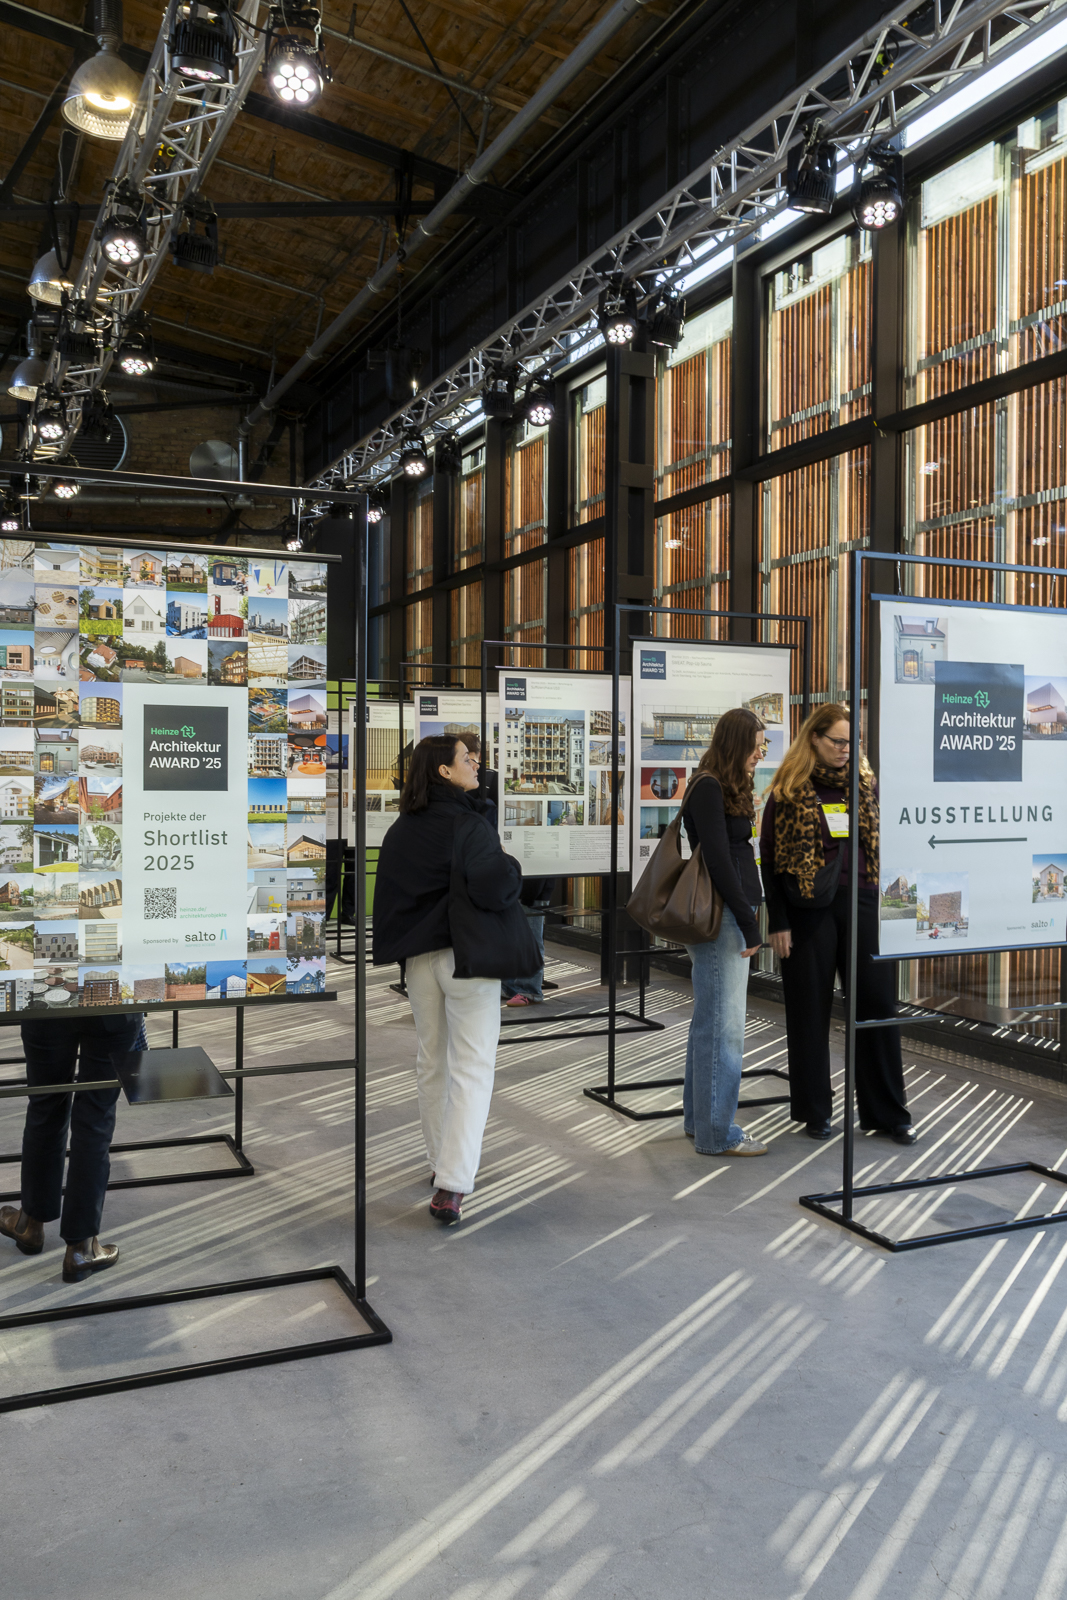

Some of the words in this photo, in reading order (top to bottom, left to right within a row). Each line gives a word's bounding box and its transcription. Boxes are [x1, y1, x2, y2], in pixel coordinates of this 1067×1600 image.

[942, 693, 973, 704] Heinze
[940, 711, 1016, 728] Architektur
[150, 727, 179, 735] Heinze
[149, 740, 221, 752] Architektur
[939, 734, 994, 750] AWARD
[996, 735, 1016, 751] '25
[149, 757, 200, 769] AWARD
[202, 757, 222, 769] '25
[143, 812, 187, 823] Projekte
[189, 812, 207, 821] der
[899, 805, 1053, 825] AUSSTELLUNG
[143, 829, 228, 846] Shortlist
[144, 855, 195, 871] 2025
[1031, 919, 1049, 929] salto
[185, 931, 217, 942] salto
